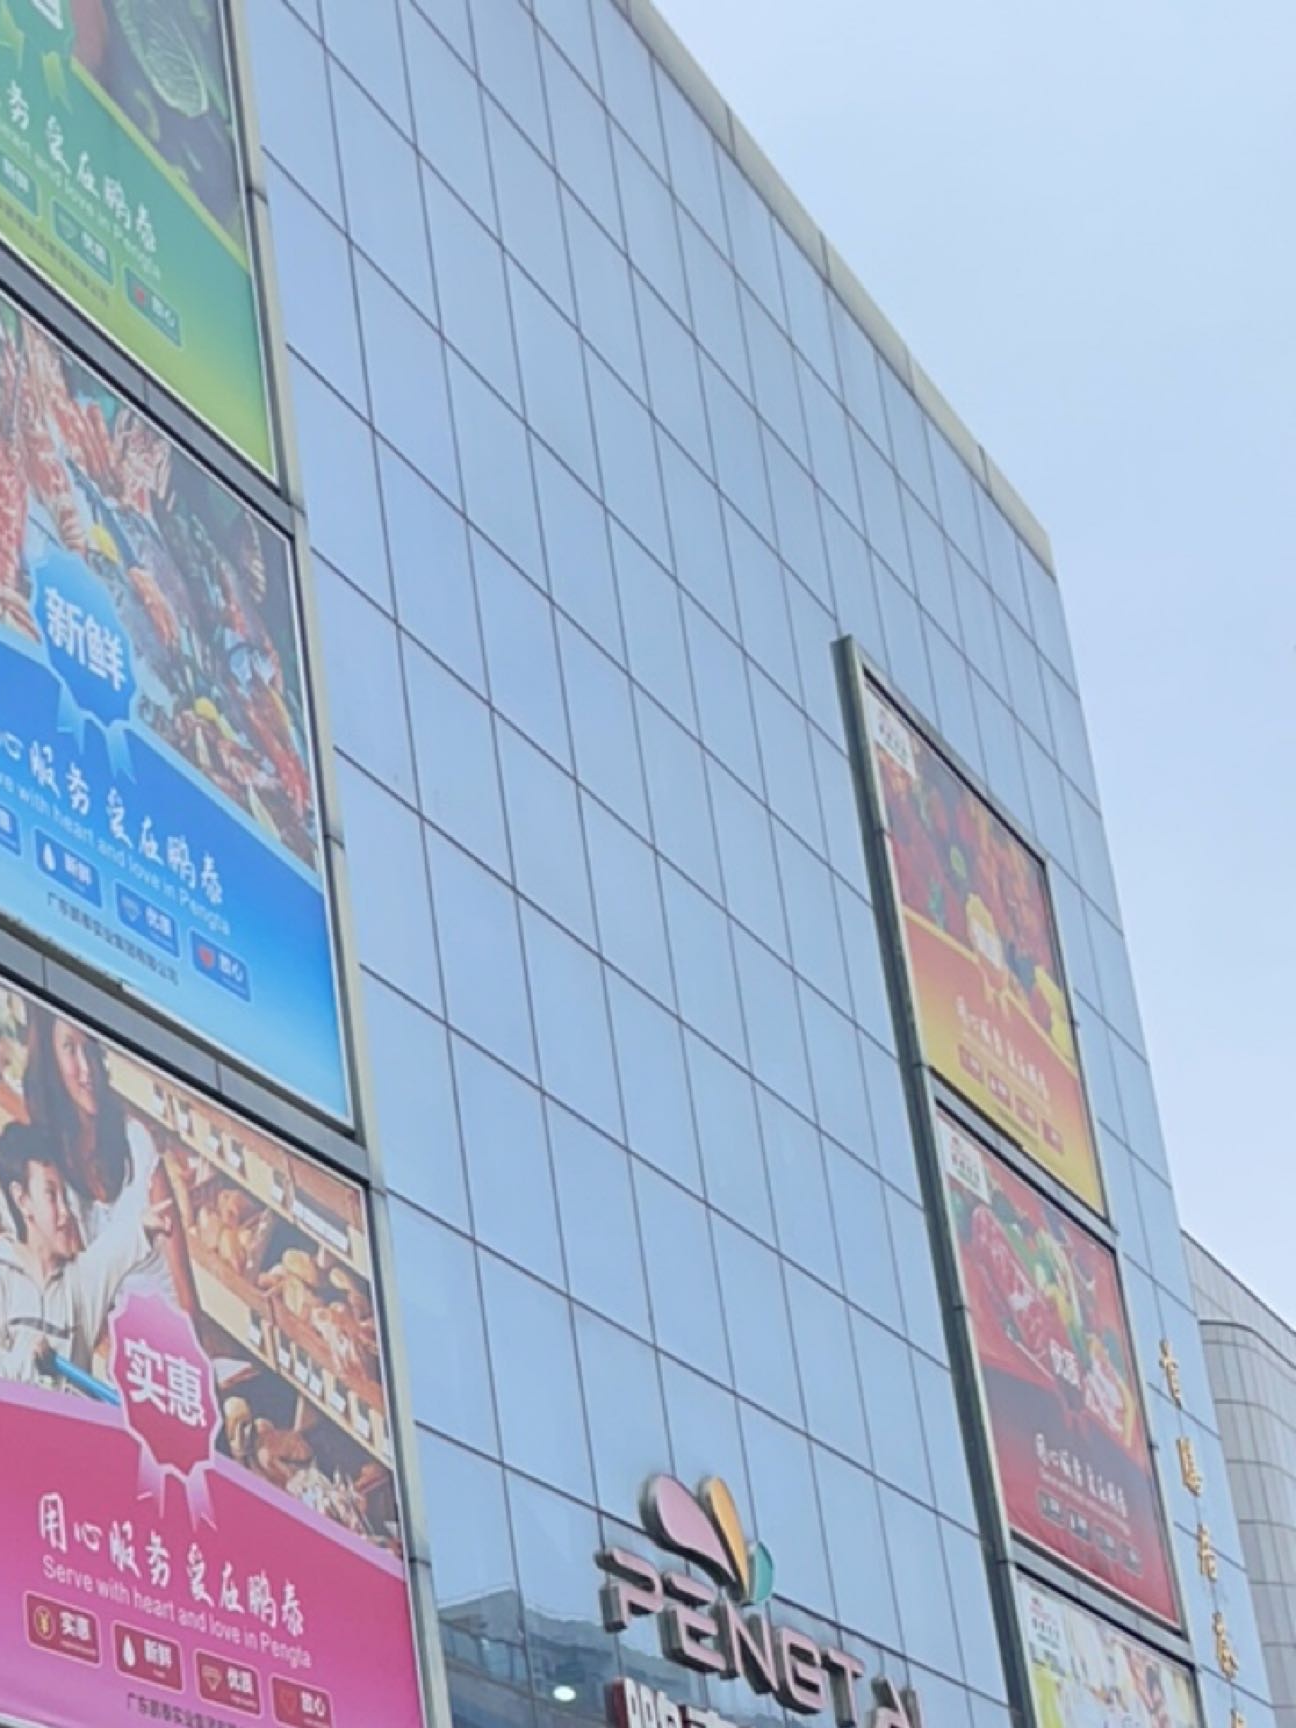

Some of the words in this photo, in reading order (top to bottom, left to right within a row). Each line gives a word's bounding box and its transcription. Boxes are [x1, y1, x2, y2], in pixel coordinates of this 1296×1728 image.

[42, 570, 128, 692] 新鲜
[122, 1337, 208, 1428] 实惠
[42, 1553, 94, 1593] Serve
[95, 1576, 131, 1606] with
[131, 1585, 175, 1623] heart
[177, 1606, 208, 1634] and
[208, 1611, 242, 1646] love
[243, 1626, 259, 1651] in
